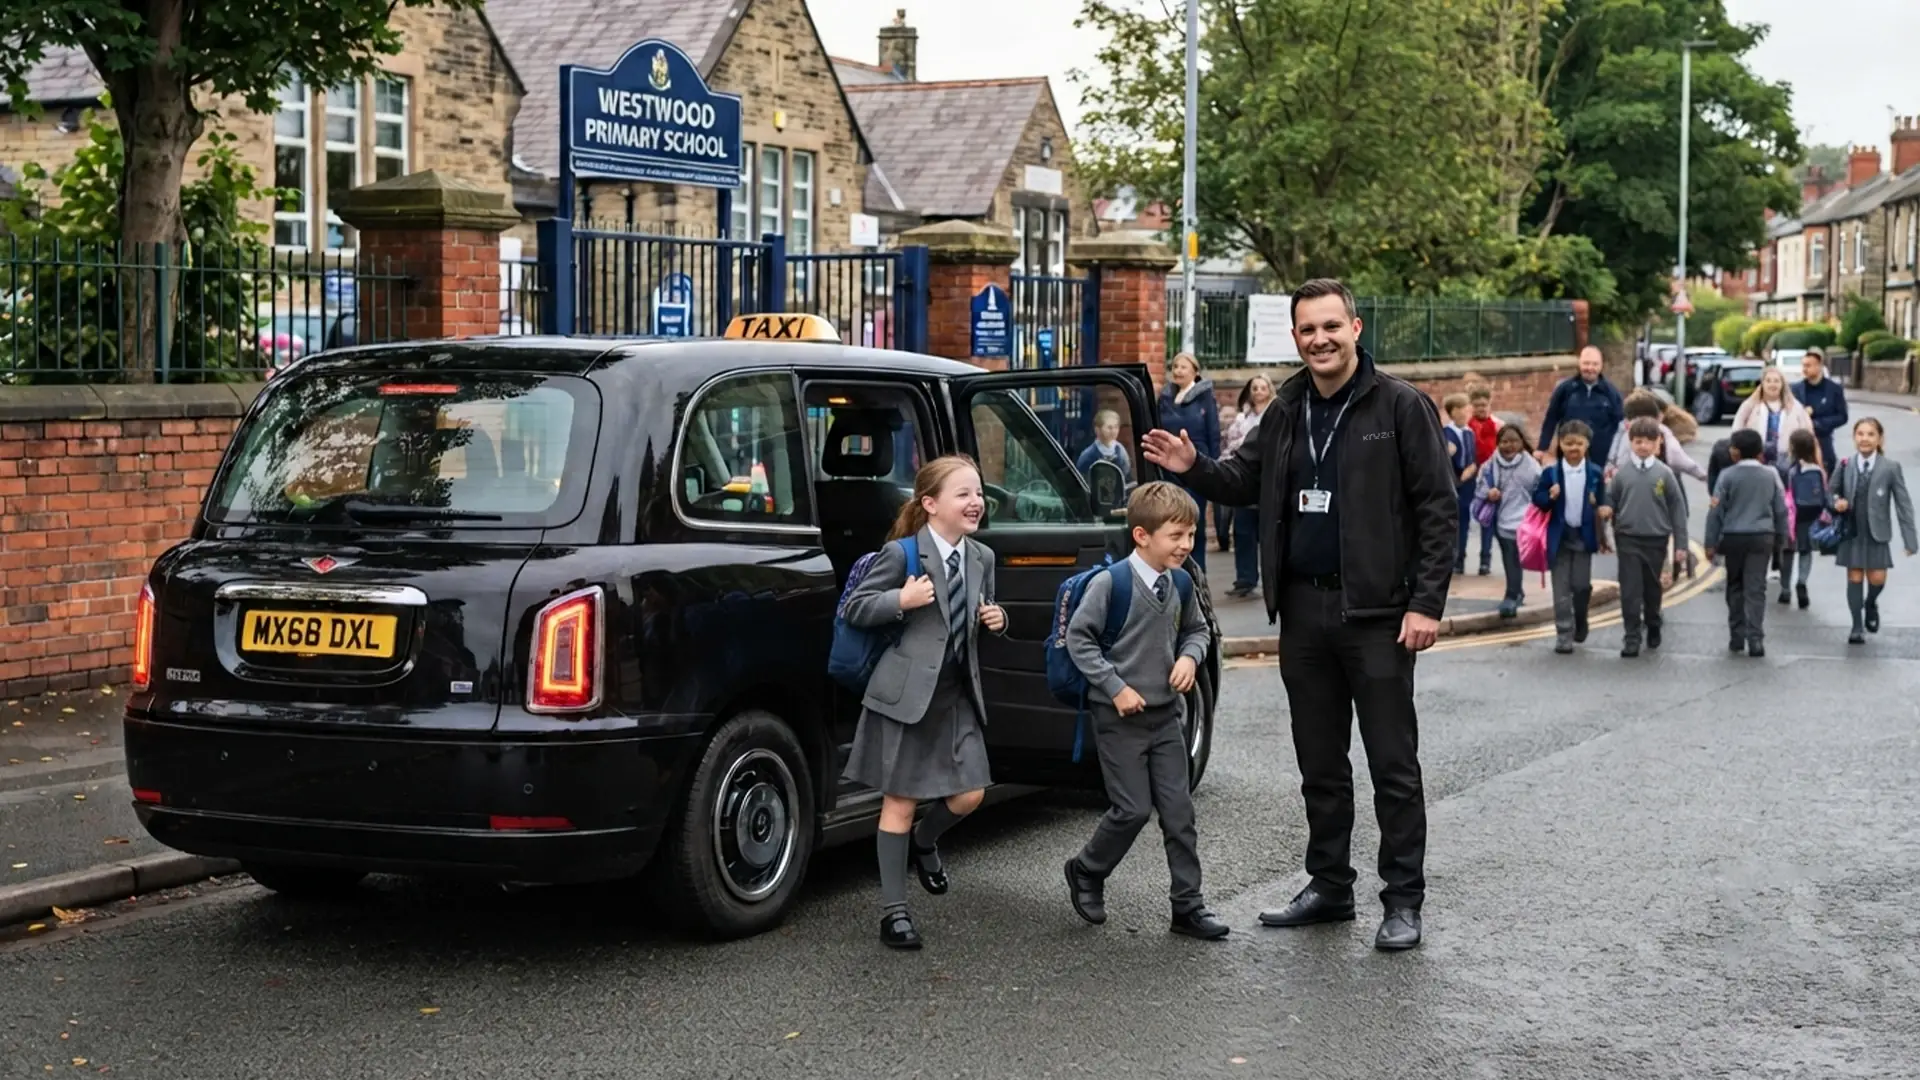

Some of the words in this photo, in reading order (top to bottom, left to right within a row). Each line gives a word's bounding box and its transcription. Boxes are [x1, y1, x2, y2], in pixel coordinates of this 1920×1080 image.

[598, 87, 715, 129] WESTWOOD
[585, 118, 660, 150] PRIMARY
[663, 130, 728, 158] SCHOOL
[741, 316, 806, 339] TAXI
[252, 615, 322, 646] MX68
[328, 618, 380, 650] DXL
